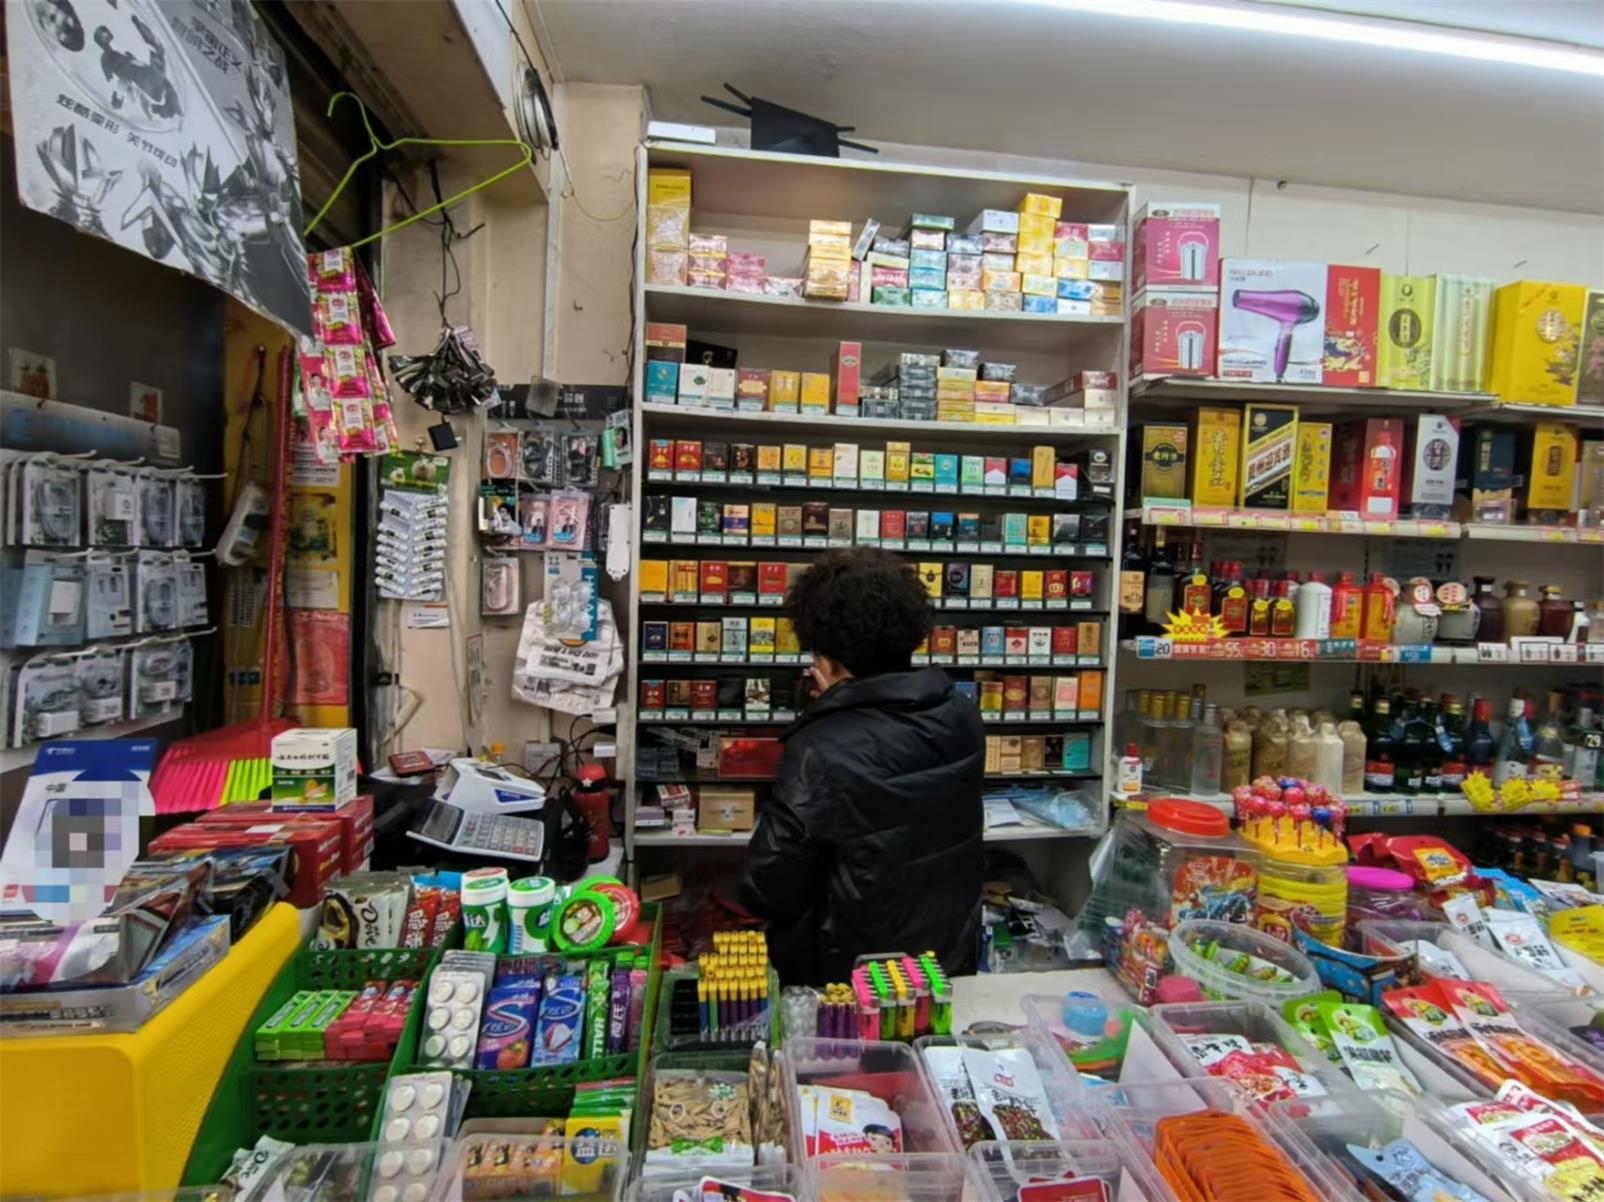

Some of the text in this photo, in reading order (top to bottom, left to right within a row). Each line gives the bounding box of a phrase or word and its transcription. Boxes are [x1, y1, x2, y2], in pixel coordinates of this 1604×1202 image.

[56, 94, 120, 135] 炫酷变形
[592, 1016, 605, 1060] HALL
